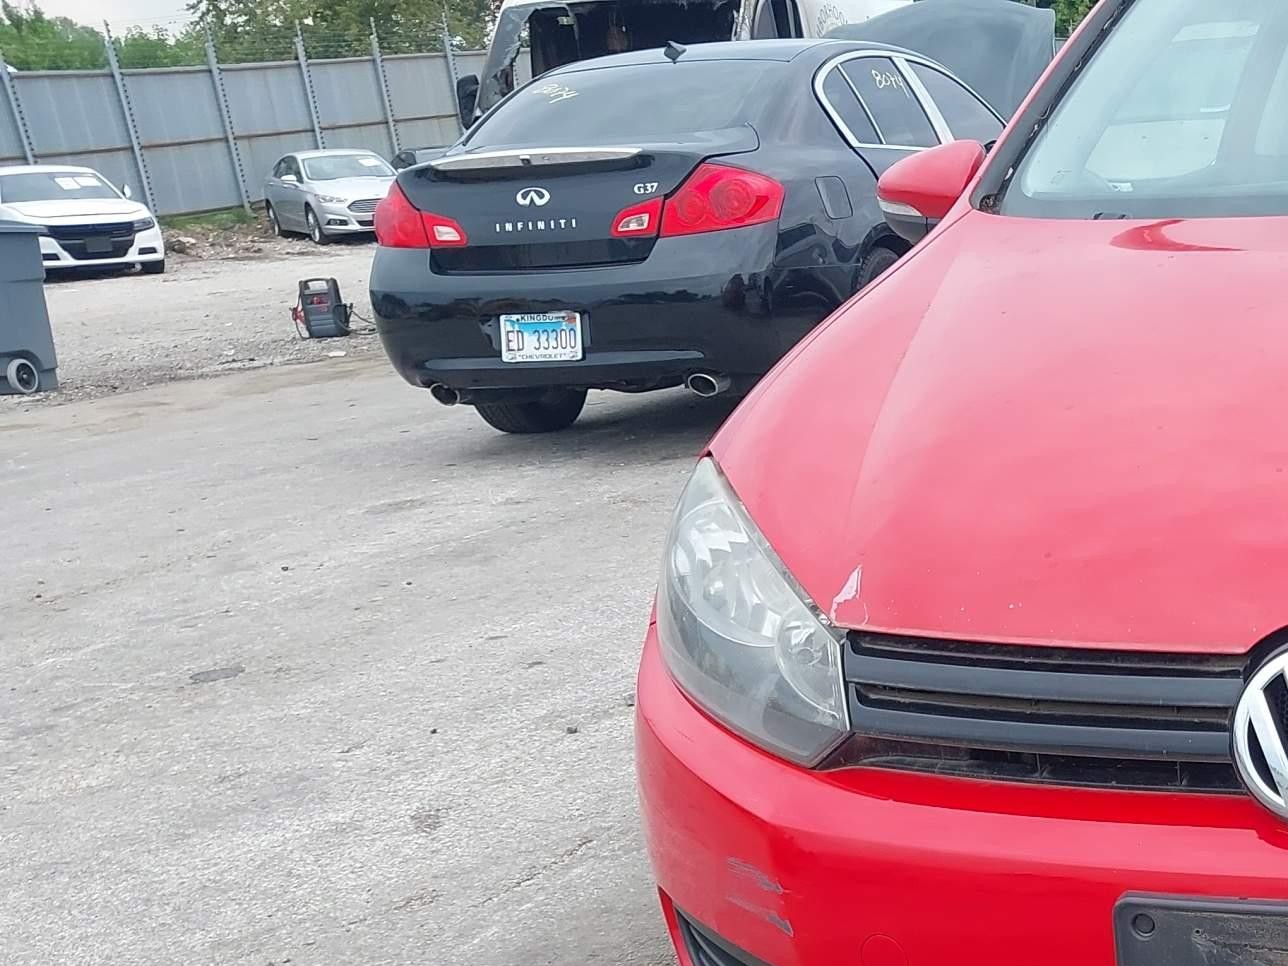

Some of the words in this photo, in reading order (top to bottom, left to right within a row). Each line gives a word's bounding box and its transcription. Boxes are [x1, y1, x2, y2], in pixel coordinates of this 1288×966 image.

[633, 182, 659, 194] G37
[496, 218, 577, 232] INFINITI
[506, 330, 524, 352] ED
[533, 328, 577, 351] 33300
